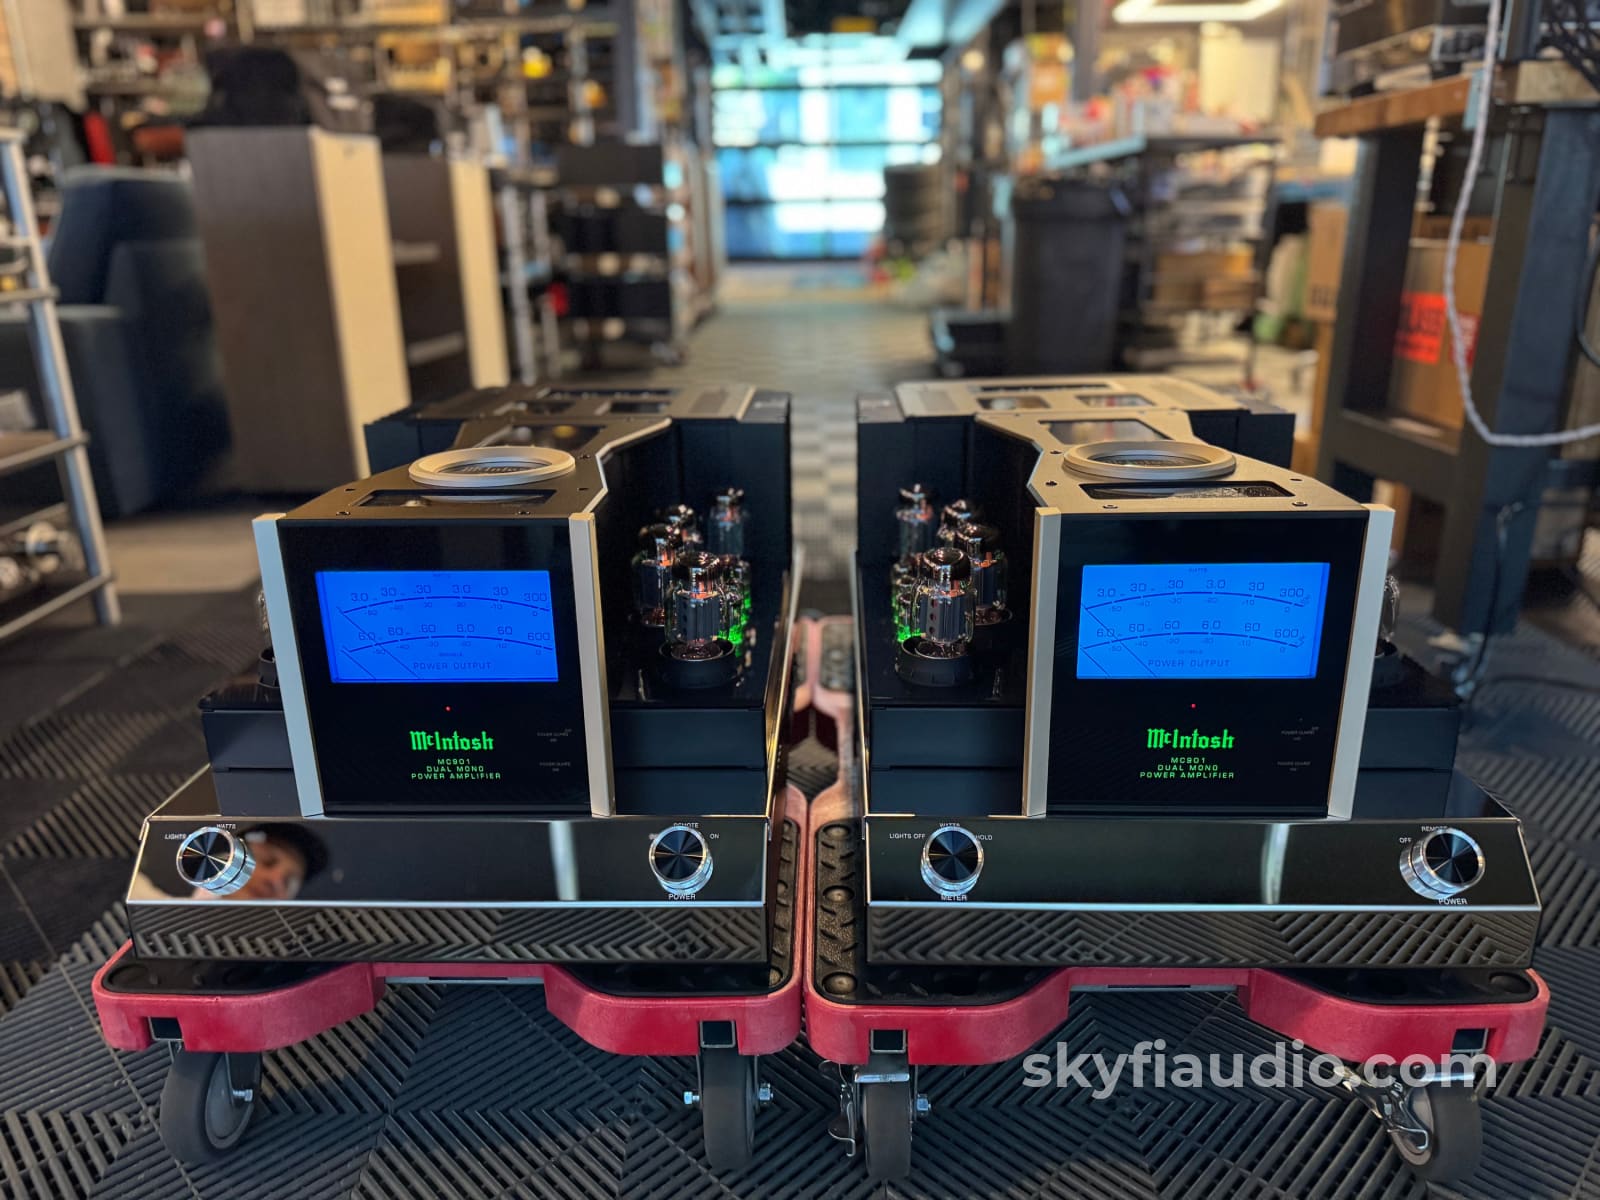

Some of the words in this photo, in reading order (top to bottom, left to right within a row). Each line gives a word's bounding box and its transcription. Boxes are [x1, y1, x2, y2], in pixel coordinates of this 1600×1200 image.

[350, 592, 368, 602] 3.0
[380, 587, 397, 597] 30
[451, 584, 471, 594] 3.0
[492, 587, 508, 596] 30
[524, 592, 547, 602] 300
[1097, 588, 1116, 597] 3.0
[1130, 583, 1147, 592] 30
[1206, 579, 1226, 589] 3.0
[1248, 582, 1264, 591] 30
[1280, 588, 1304, 598] 300
[498, 626, 513, 635] 60
[528, 632, 550, 641] 600
[1096, 628, 1115, 637] 6.0
[1202, 620, 1221, 630] 6.0
[1244, 623, 1261, 632] 60
[1274, 629, 1298, 638] 600
[454, 662, 491, 670] OUTPUT
[1148, 659, 1184, 667] POWER
[1190, 659, 1230, 668] OUTPUT
[409, 730, 494, 750] McIntosh
[1147, 728, 1235, 749] McIntosh
